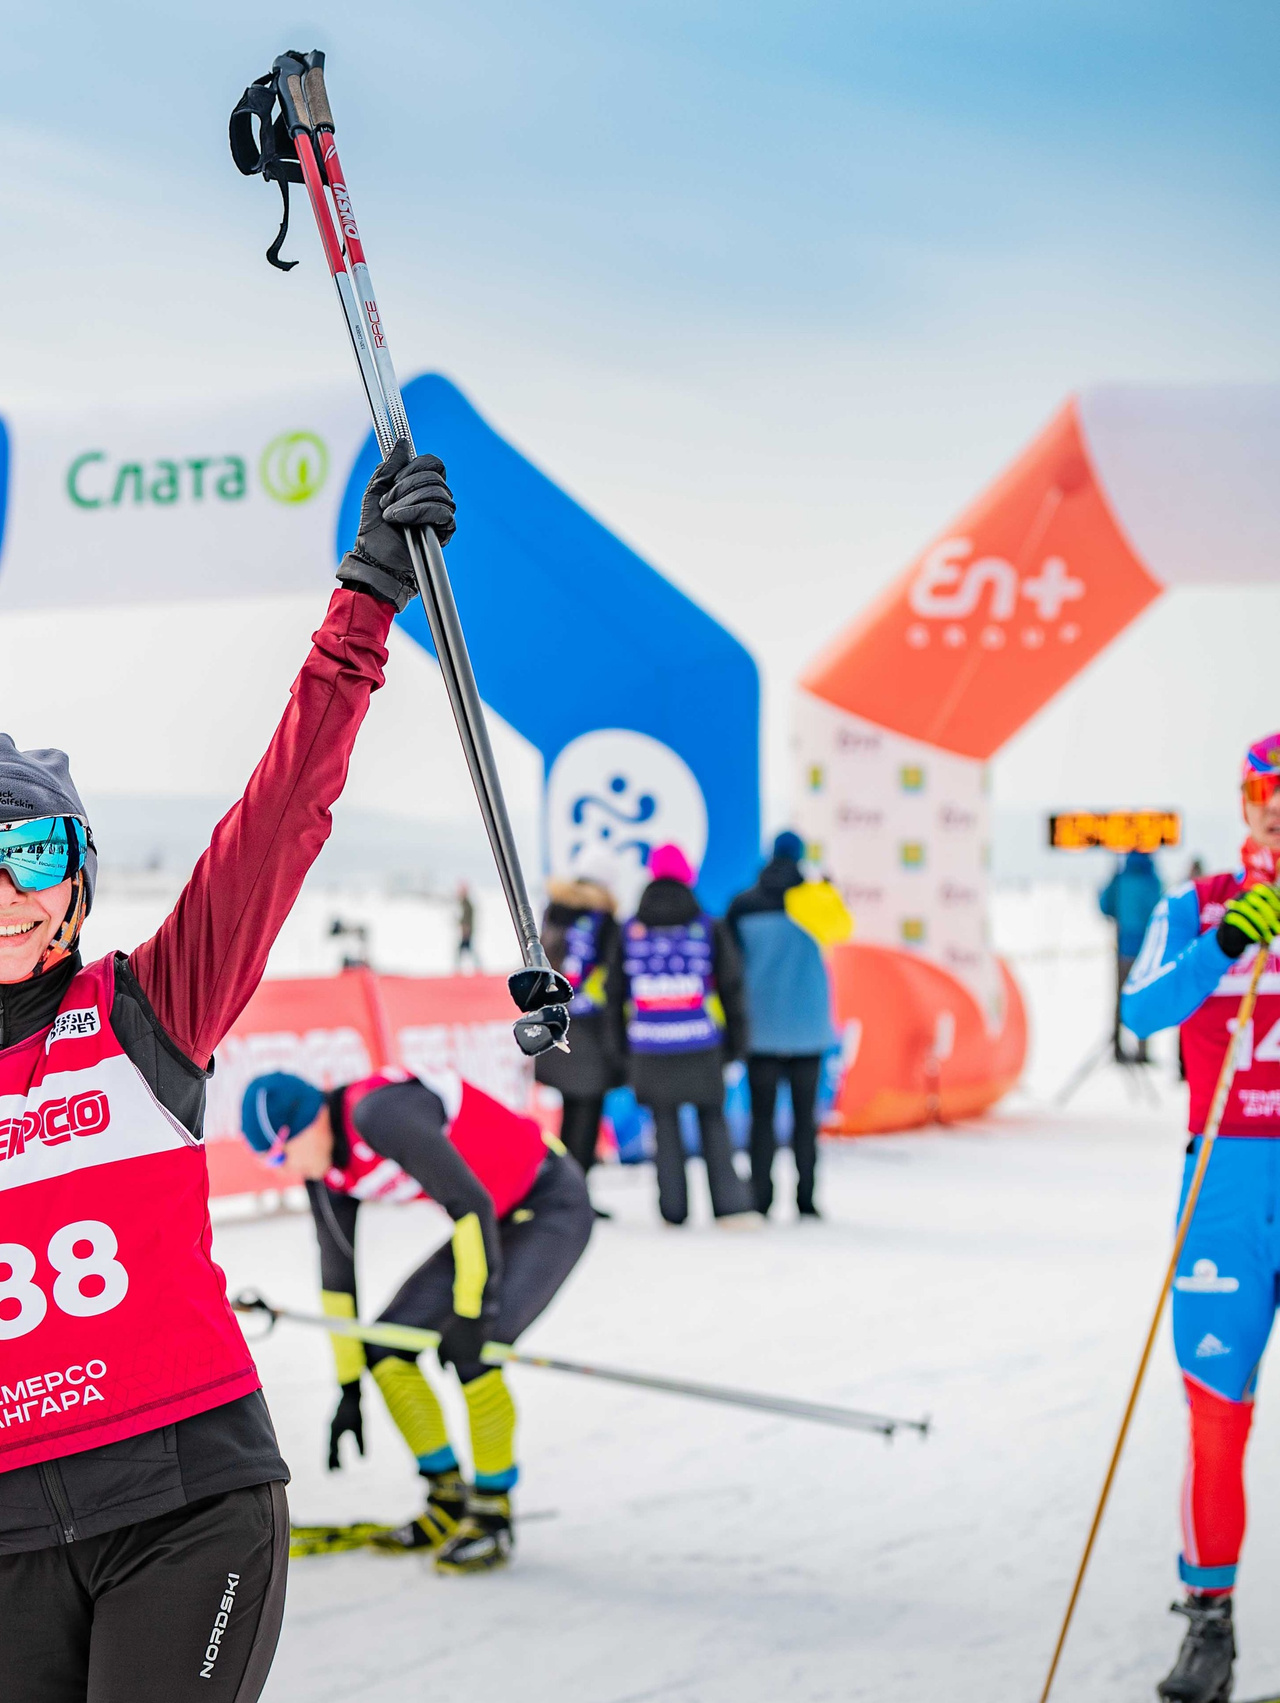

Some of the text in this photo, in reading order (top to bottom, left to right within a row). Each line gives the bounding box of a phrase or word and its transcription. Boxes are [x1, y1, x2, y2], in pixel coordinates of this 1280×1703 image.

[365, 300, 386, 349] RACE
[66, 450, 246, 510] Слата
[199, 1572, 240, 1679] NORDSKI
